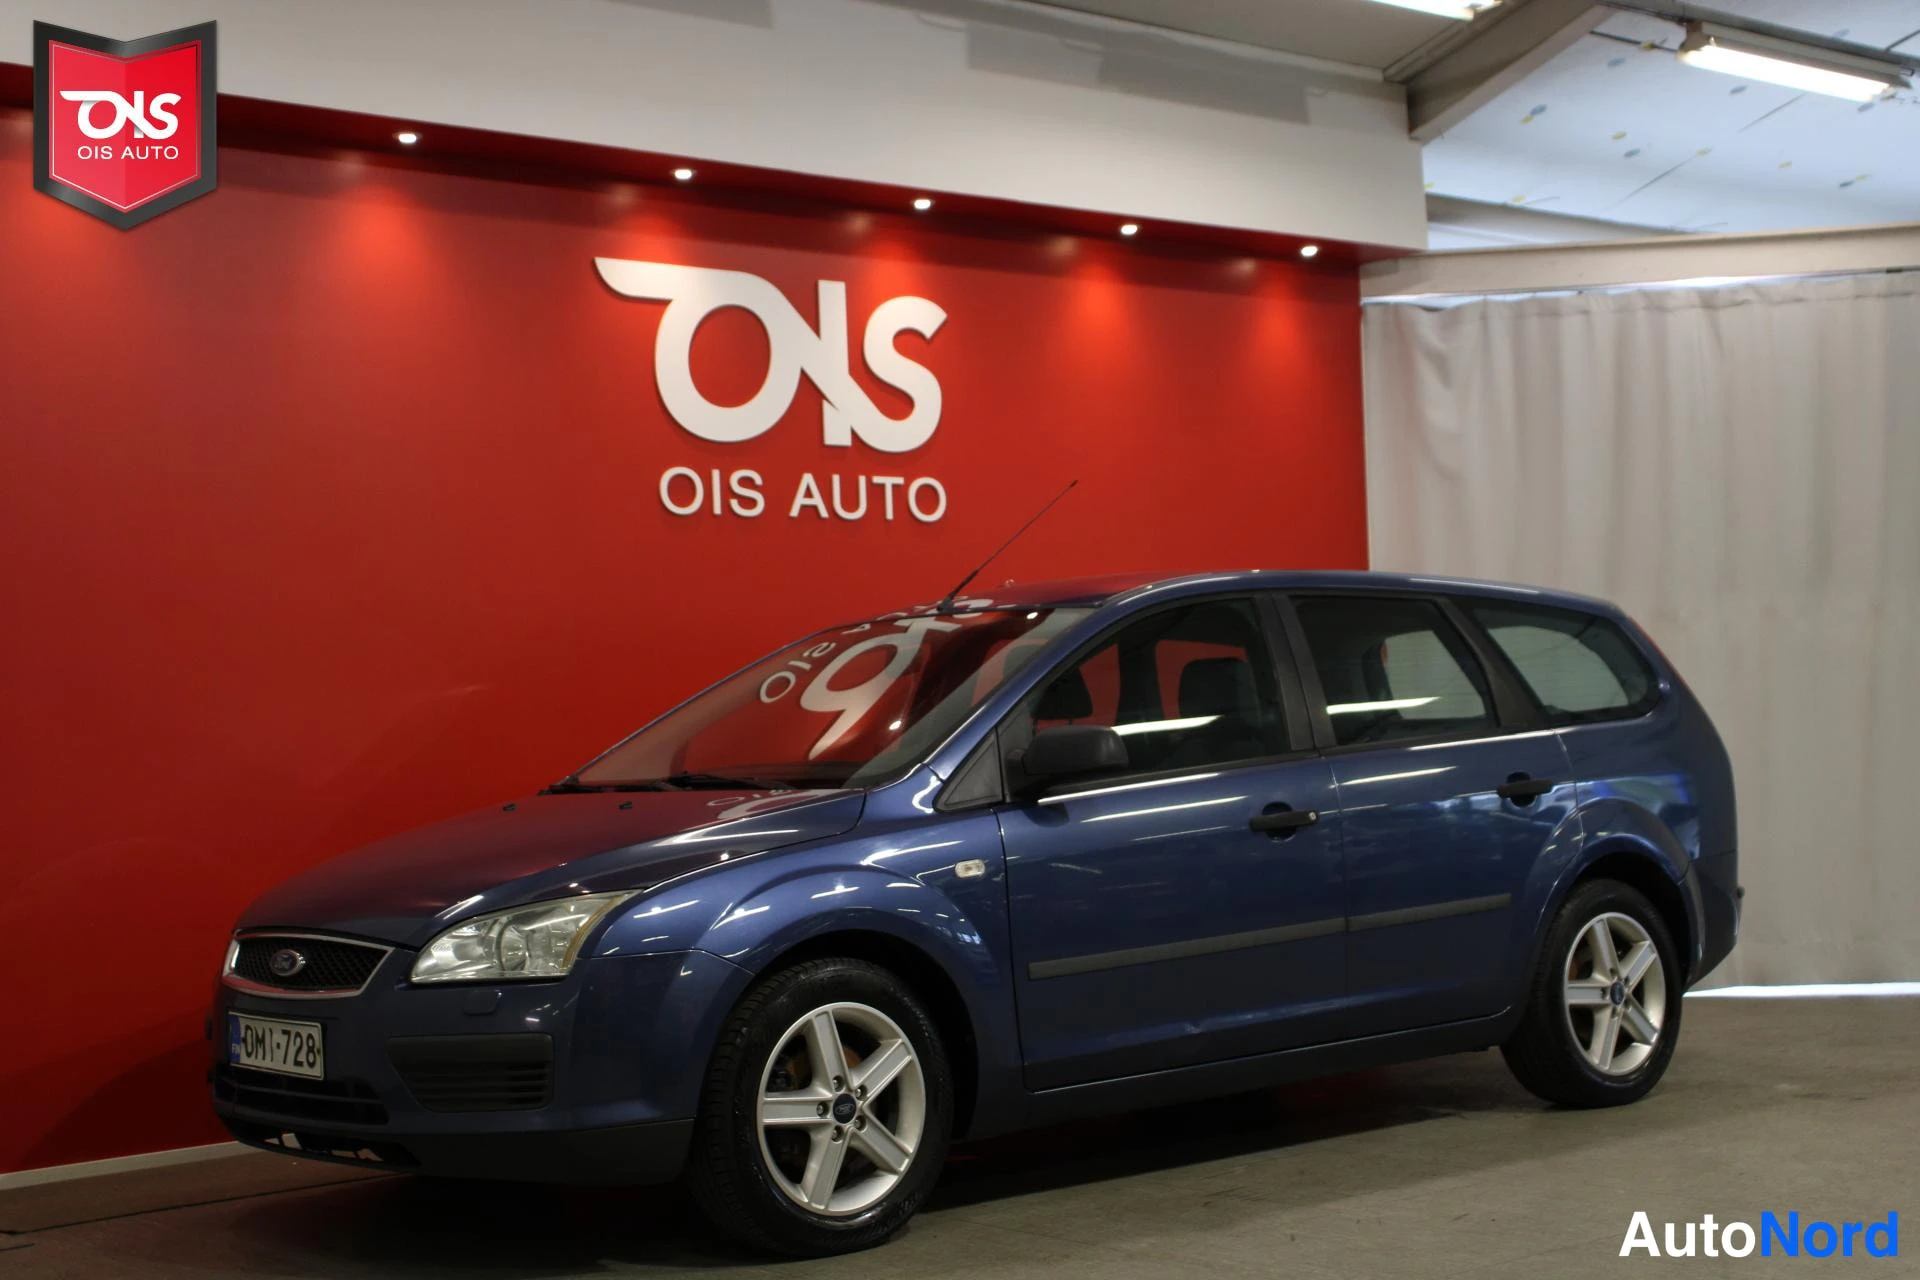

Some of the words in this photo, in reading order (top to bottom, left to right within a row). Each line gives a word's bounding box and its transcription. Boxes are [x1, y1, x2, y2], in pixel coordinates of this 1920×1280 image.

[594, 256, 948, 454] OIS
[659, 466, 765, 517] OIS
[789, 472, 947, 523] AUTO
[244, 1024, 317, 1069] OMI-728
